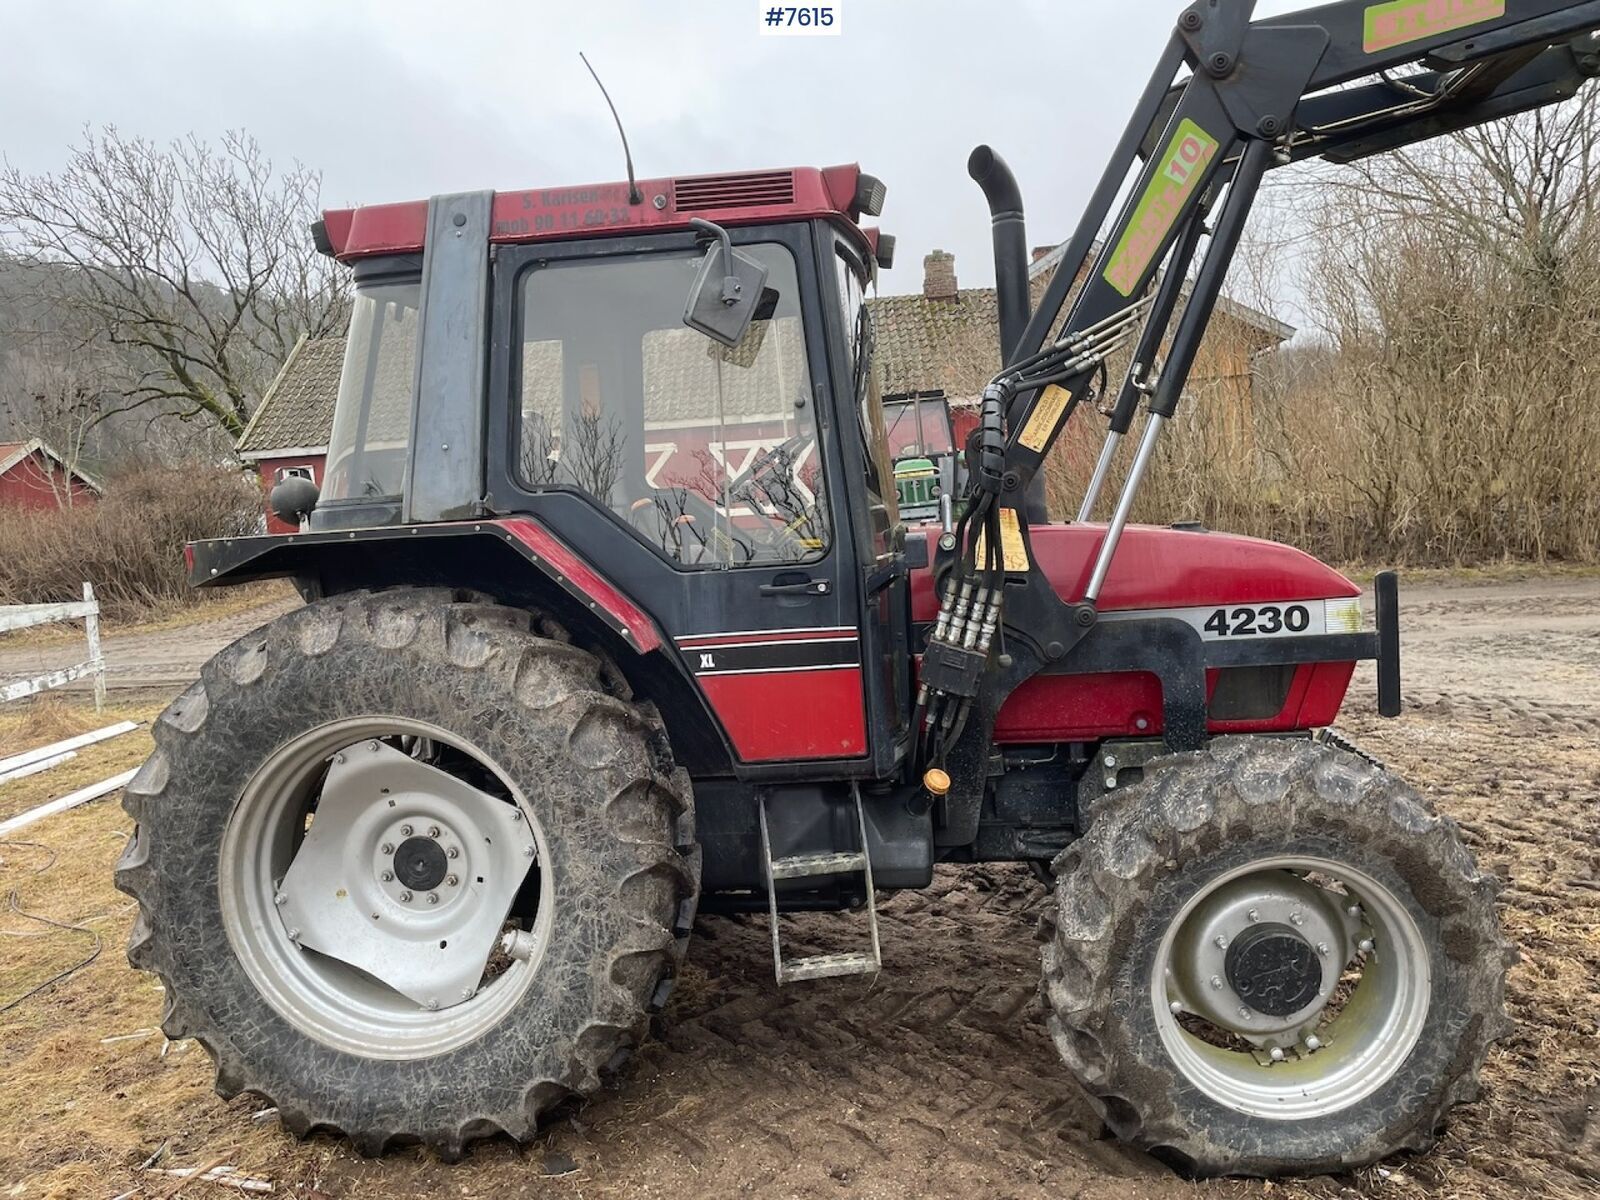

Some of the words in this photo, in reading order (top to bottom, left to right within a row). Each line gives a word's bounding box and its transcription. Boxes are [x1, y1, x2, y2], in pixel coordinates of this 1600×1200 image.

[1170, 137, 1201, 179] 10
[1204, 604, 1310, 636] 4230
[700, 653, 715, 668] XL
